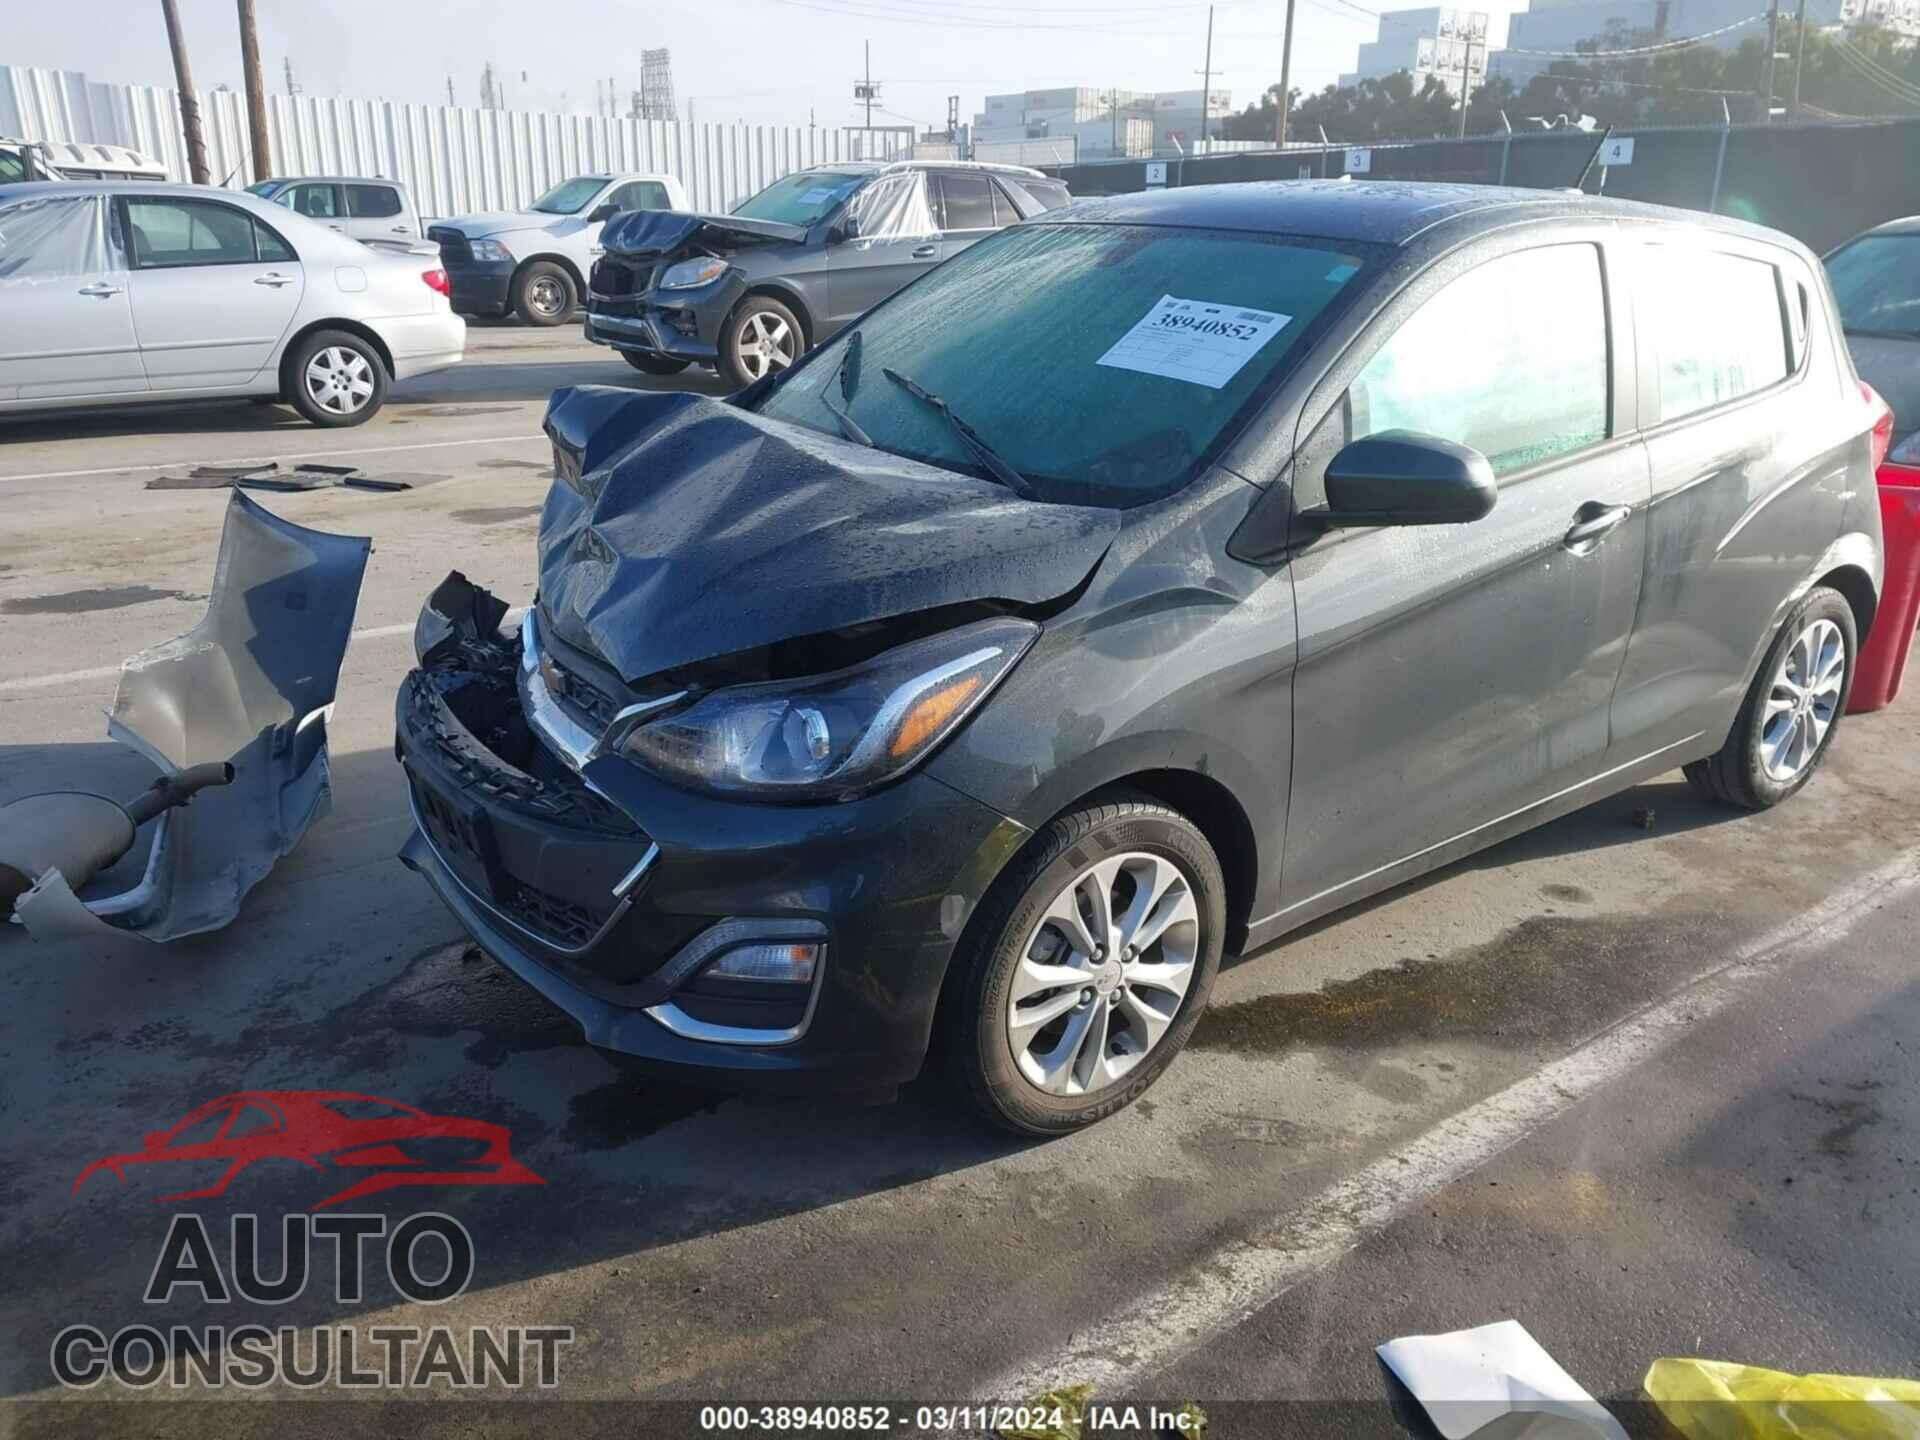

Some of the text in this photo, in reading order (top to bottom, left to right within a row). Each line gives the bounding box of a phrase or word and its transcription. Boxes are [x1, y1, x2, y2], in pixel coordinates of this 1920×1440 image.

[1612, 145, 1621, 158] 4
[1354, 154, 1361, 168] 3
[1153, 167, 1160, 178] 2
[1152, 313, 1259, 341] 38940852
